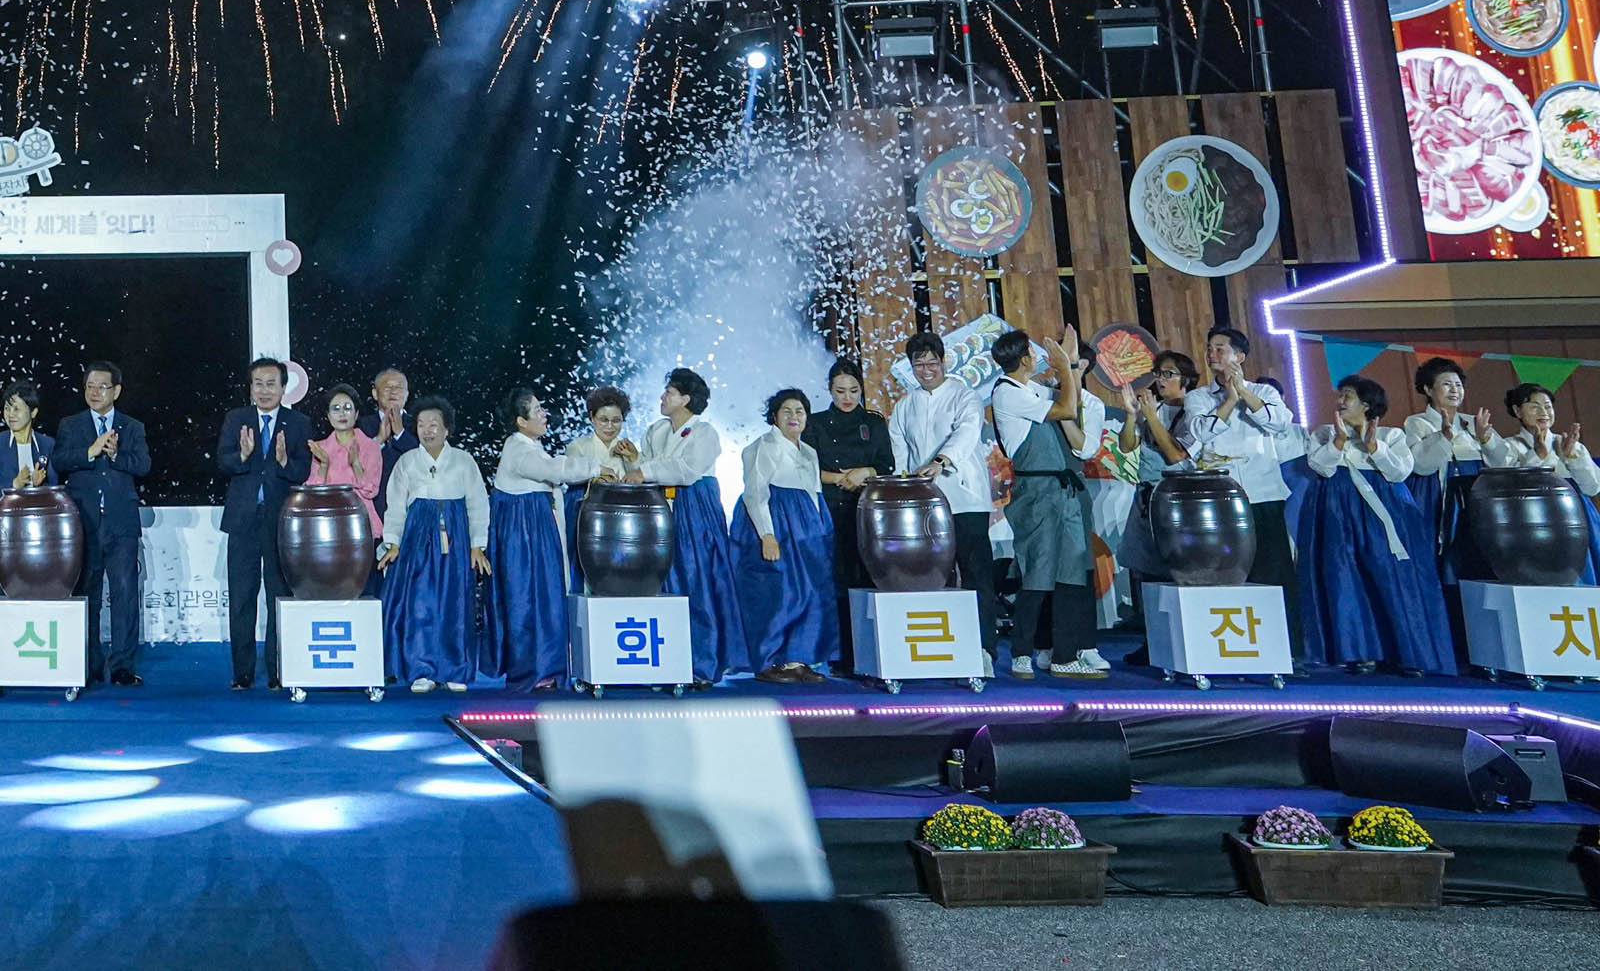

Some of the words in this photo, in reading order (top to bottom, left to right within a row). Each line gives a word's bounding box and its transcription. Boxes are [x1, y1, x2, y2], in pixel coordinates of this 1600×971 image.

[13, 621, 58, 670] 식
[308, 620, 357, 670] 문
[615, 617, 665, 668] 화
[904, 611, 956, 662] 큰
[1209, 606, 1262, 658] 잔
[1549, 605, 1600, 660] 치
